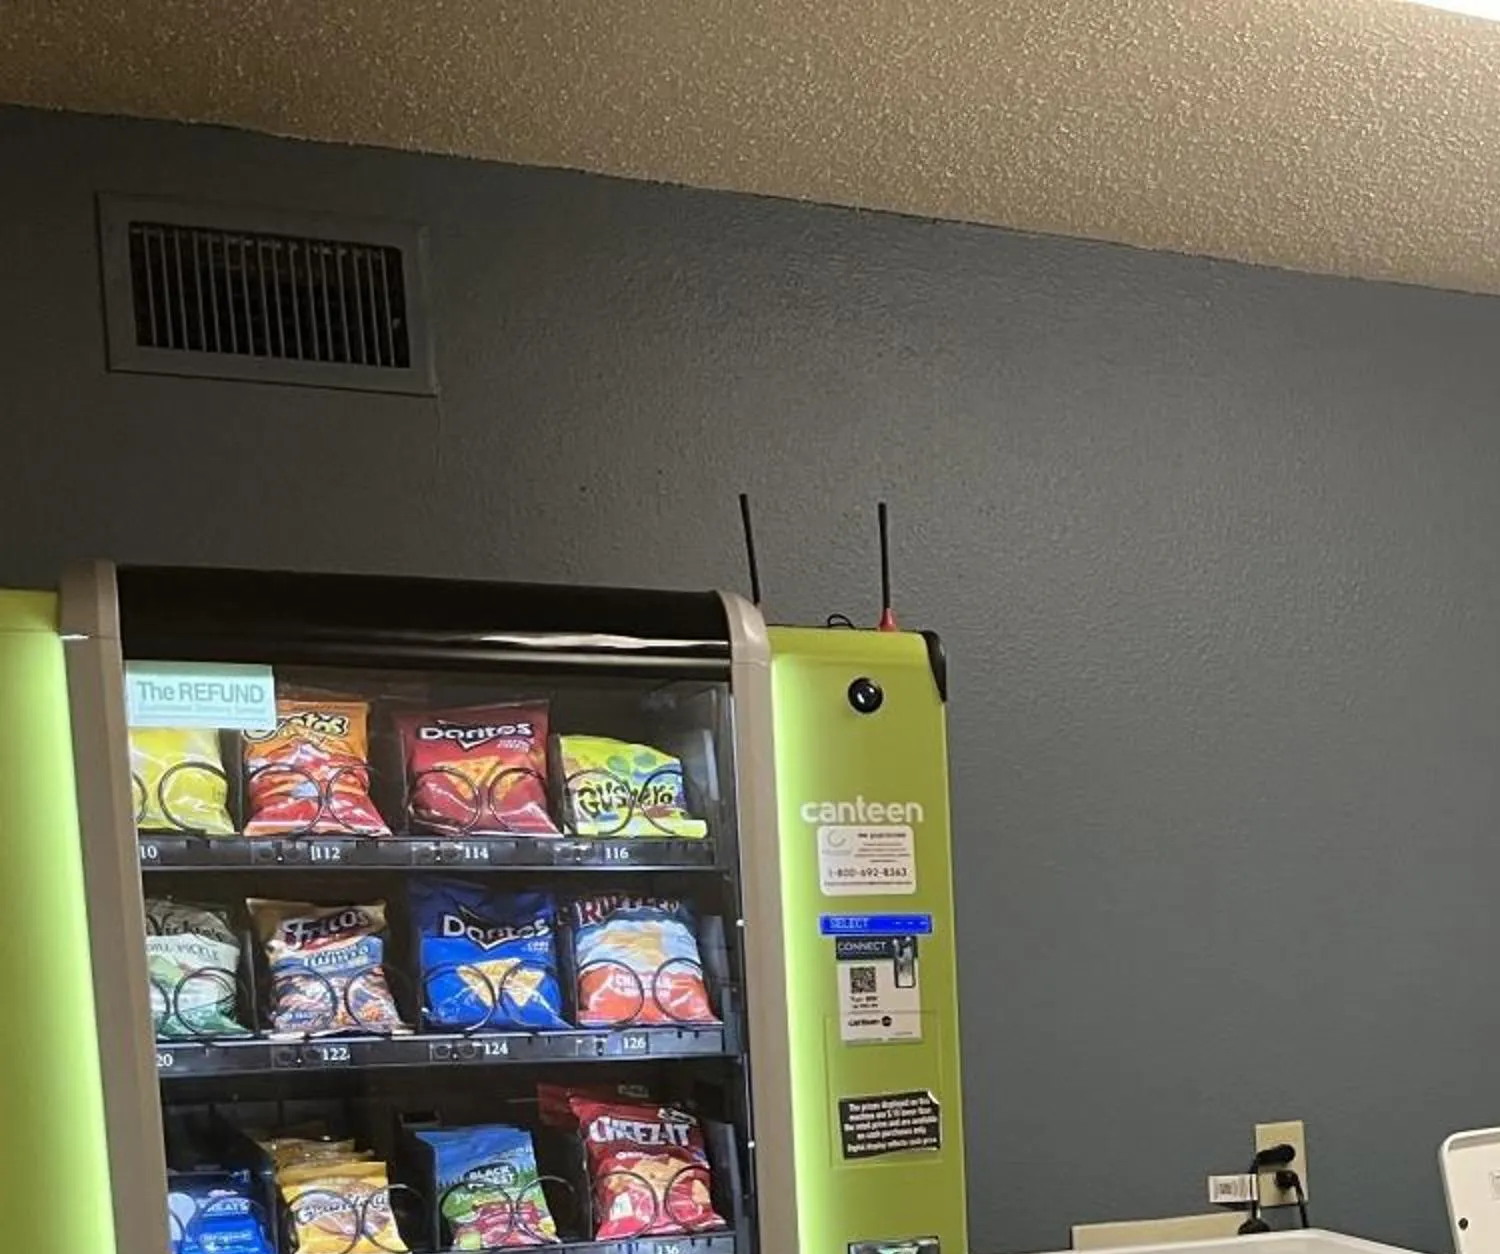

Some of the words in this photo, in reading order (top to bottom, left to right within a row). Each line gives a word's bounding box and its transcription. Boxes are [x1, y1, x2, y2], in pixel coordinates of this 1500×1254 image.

[136, 681, 175, 700] The
[179, 683, 264, 703] REFUND
[420, 722, 534, 742] Doritos
[801, 795, 924, 822] canteen
[140, 845, 158, 859] 10
[464, 848, 489, 860] 114
[605, 848, 629, 860] 116
[444, 915, 550, 942] Doritos
[156, 1054, 173, 1067] 20
[322, 1047, 347, 1061] 122
[483, 1043, 509, 1056] 124
[623, 1038, 646, 1050] 126
